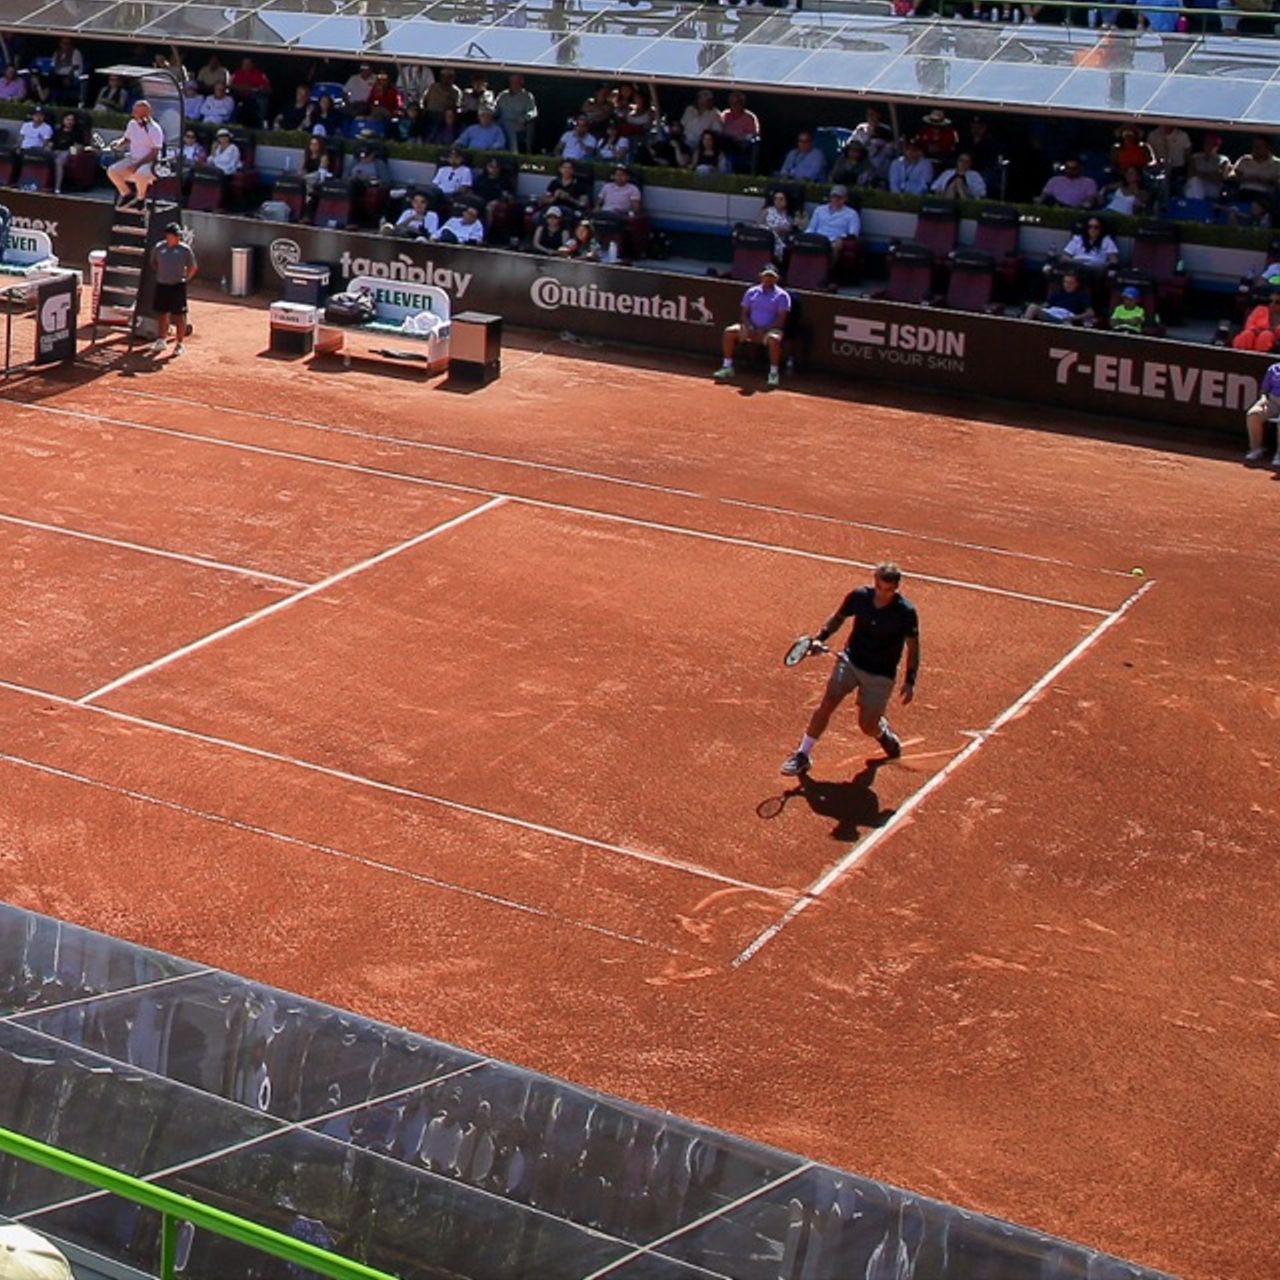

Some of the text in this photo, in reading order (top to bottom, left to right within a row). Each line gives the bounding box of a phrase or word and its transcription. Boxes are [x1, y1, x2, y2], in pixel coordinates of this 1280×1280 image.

[530, 276, 688, 322] Continental
[832, 341, 964, 373] LOVE YOUR SKIN
[889, 323, 965, 358] ISDIN
